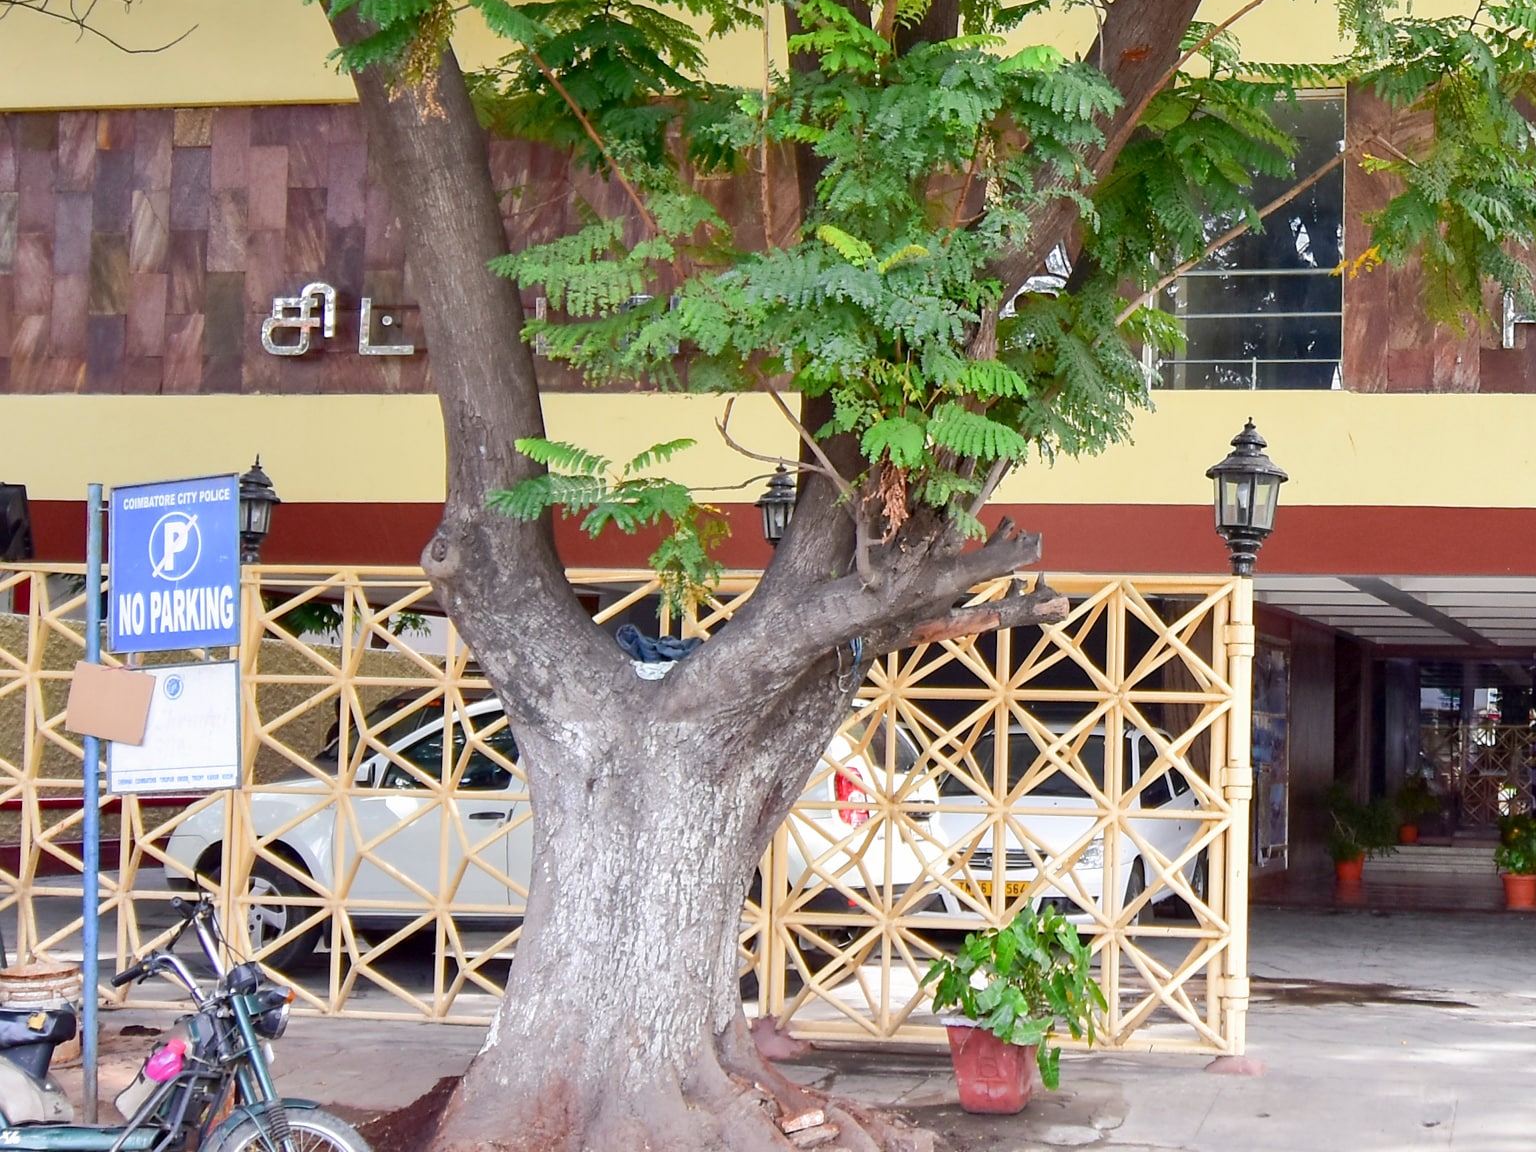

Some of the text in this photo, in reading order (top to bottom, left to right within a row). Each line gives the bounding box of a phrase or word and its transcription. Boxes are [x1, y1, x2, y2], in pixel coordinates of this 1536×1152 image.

[123, 488, 231, 510] COIMBATORE CITY POLICE
[164, 521, 189, 570] P
[118, 585, 234, 636] NO PARKING
